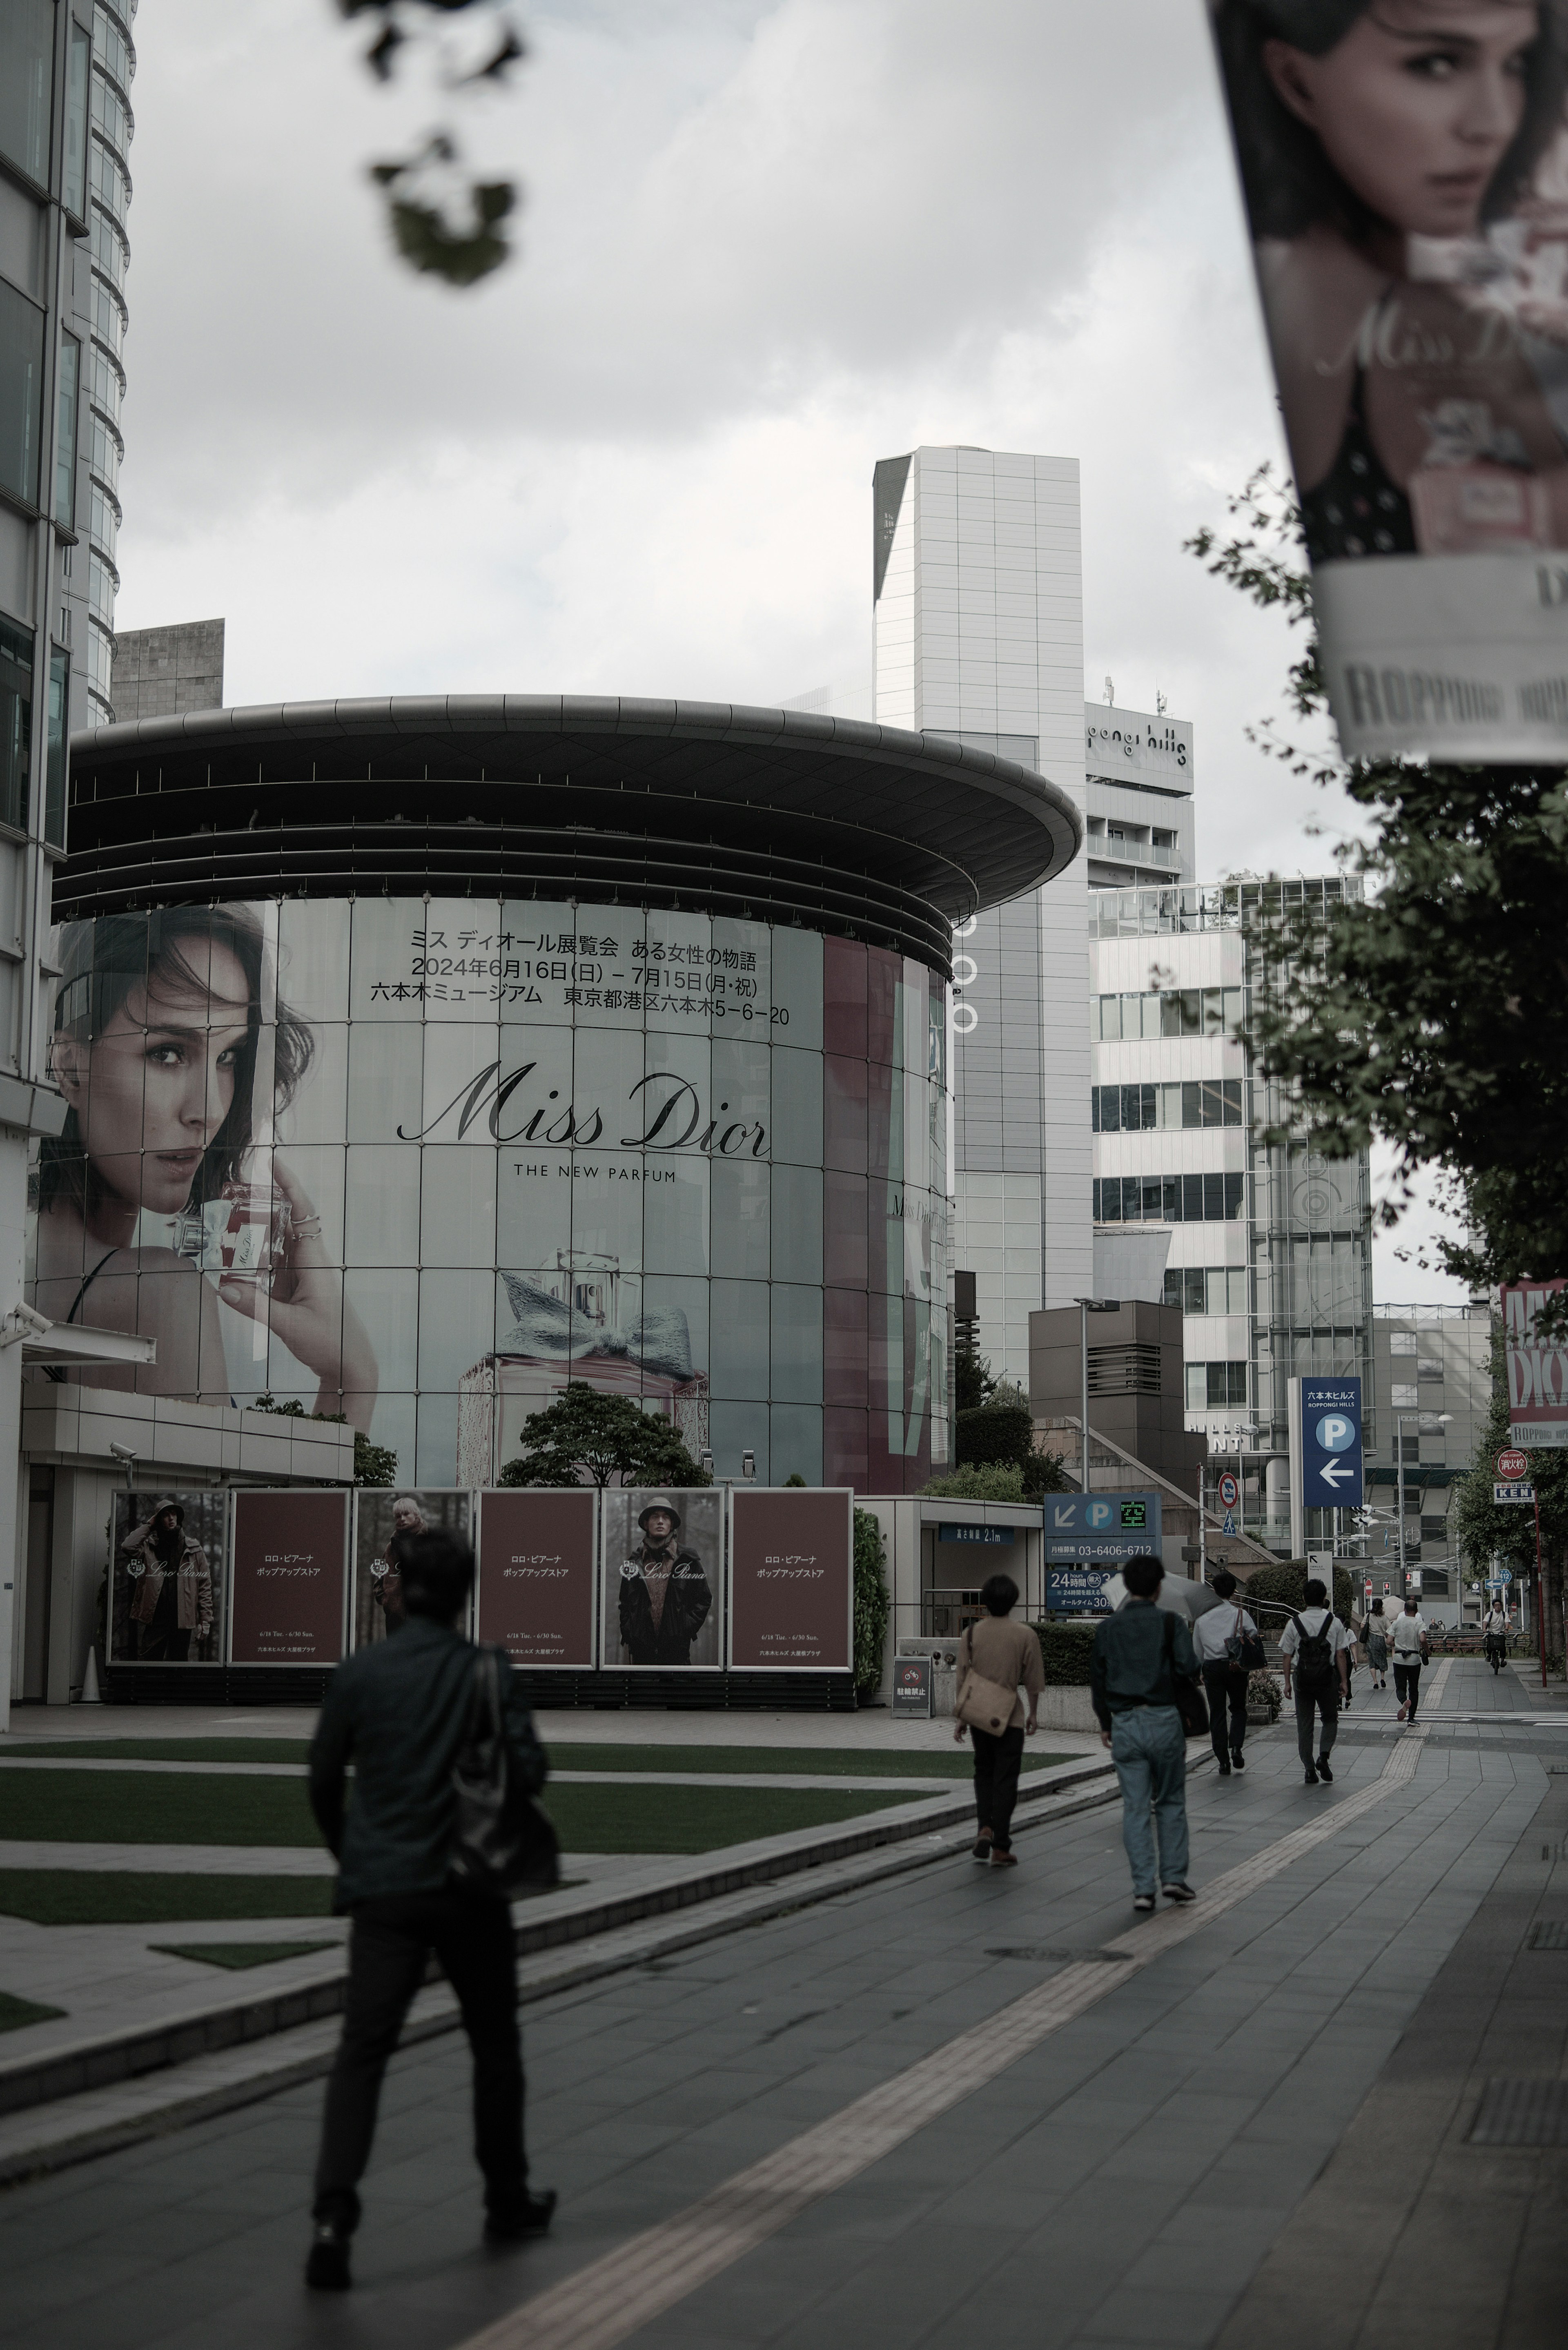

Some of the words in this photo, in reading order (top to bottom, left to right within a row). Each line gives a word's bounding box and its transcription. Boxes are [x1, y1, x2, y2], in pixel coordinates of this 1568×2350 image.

[411, 930, 448, 950] ミス
[458, 930, 619, 958] ディオール展覧会
[631, 940, 757, 972] ある女性の物語
[371, 983, 543, 1005] 六本木ミュージアム
[397, 1060, 603, 1145] Miss
[620, 1072, 771, 1157] Dior
[514, 1164, 548, 1177] THE
[559, 1165, 599, 1178] NEW
[609, 1168, 676, 1183] PARFUM
[243, 1230, 253, 1247] Dior
[239, 1248, 249, 1268] Miss
[1307, 1391, 1355, 1400] 六本木ヒルズ
[1325, 1419, 1346, 1447] P
[1501, 1458, 1524, 1470] 消火栓
[1499, 1489, 1528, 1497] KEN
[1092, 1504, 1109, 1526] P
[1121, 1501, 1145, 1526] 空
[984, 1528, 1000, 1542] 2.1m
[512, 1555, 561, 1563] ロロ・ピアーナ
[1079, 1546, 1152, 1555] 03-6406-6712
[146, 1561, 176, 1577] Loro
[177, 1559, 210, 1576] Piana
[765, 1556, 817, 1564] ロロ・ピアーナ
[257, 1567, 321, 1576] ポップアップストア
[503, 1568, 569, 1577] ポップアップストア
[639, 1562, 671, 1579] Loro
[672, 1561, 706, 1579] Piana
[757, 1568, 824, 1578] ポップアップストア
